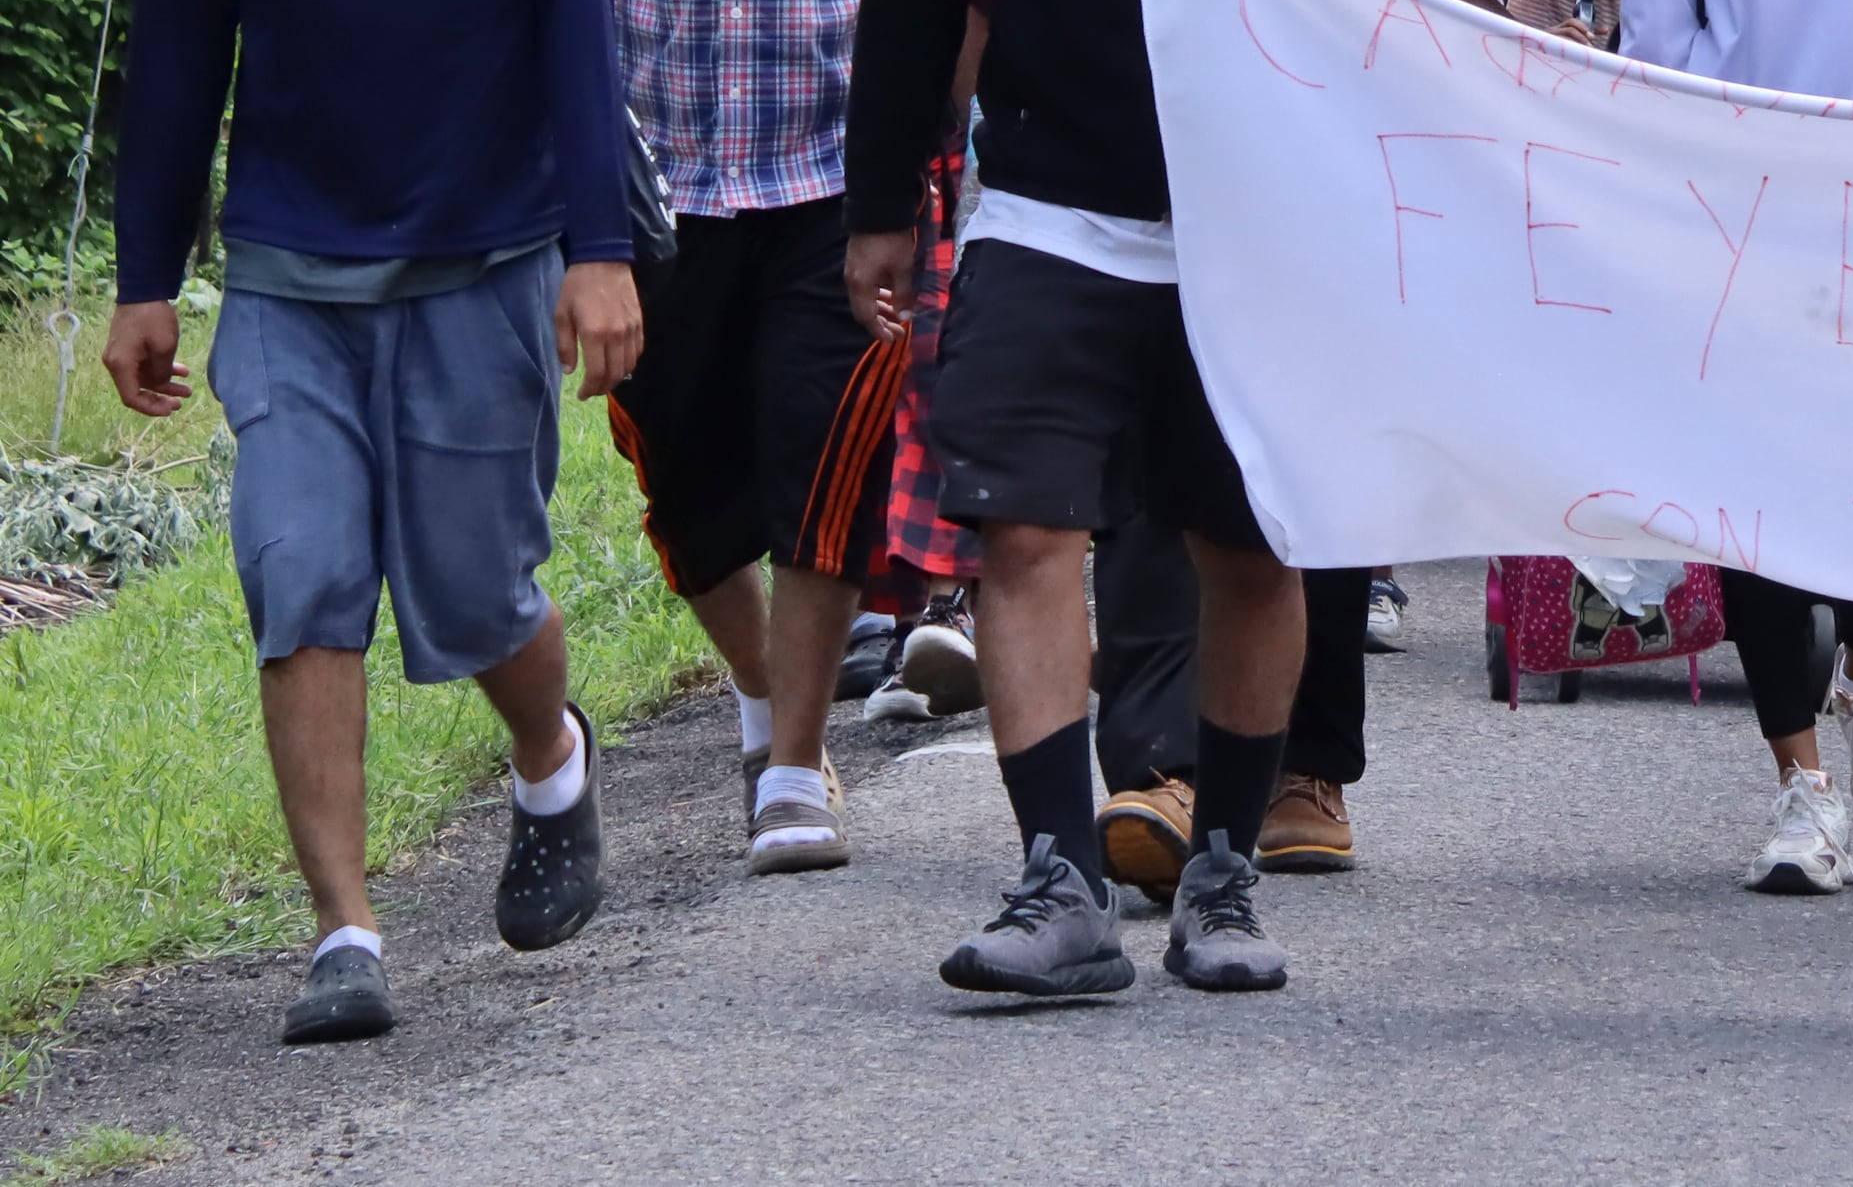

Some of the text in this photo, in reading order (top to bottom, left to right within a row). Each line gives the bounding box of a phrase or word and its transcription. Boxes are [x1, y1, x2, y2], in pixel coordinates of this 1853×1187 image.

[1377, 134, 1621, 314] FE
[1687, 175, 1768, 380] Y
[1564, 489, 1762, 574] CON
